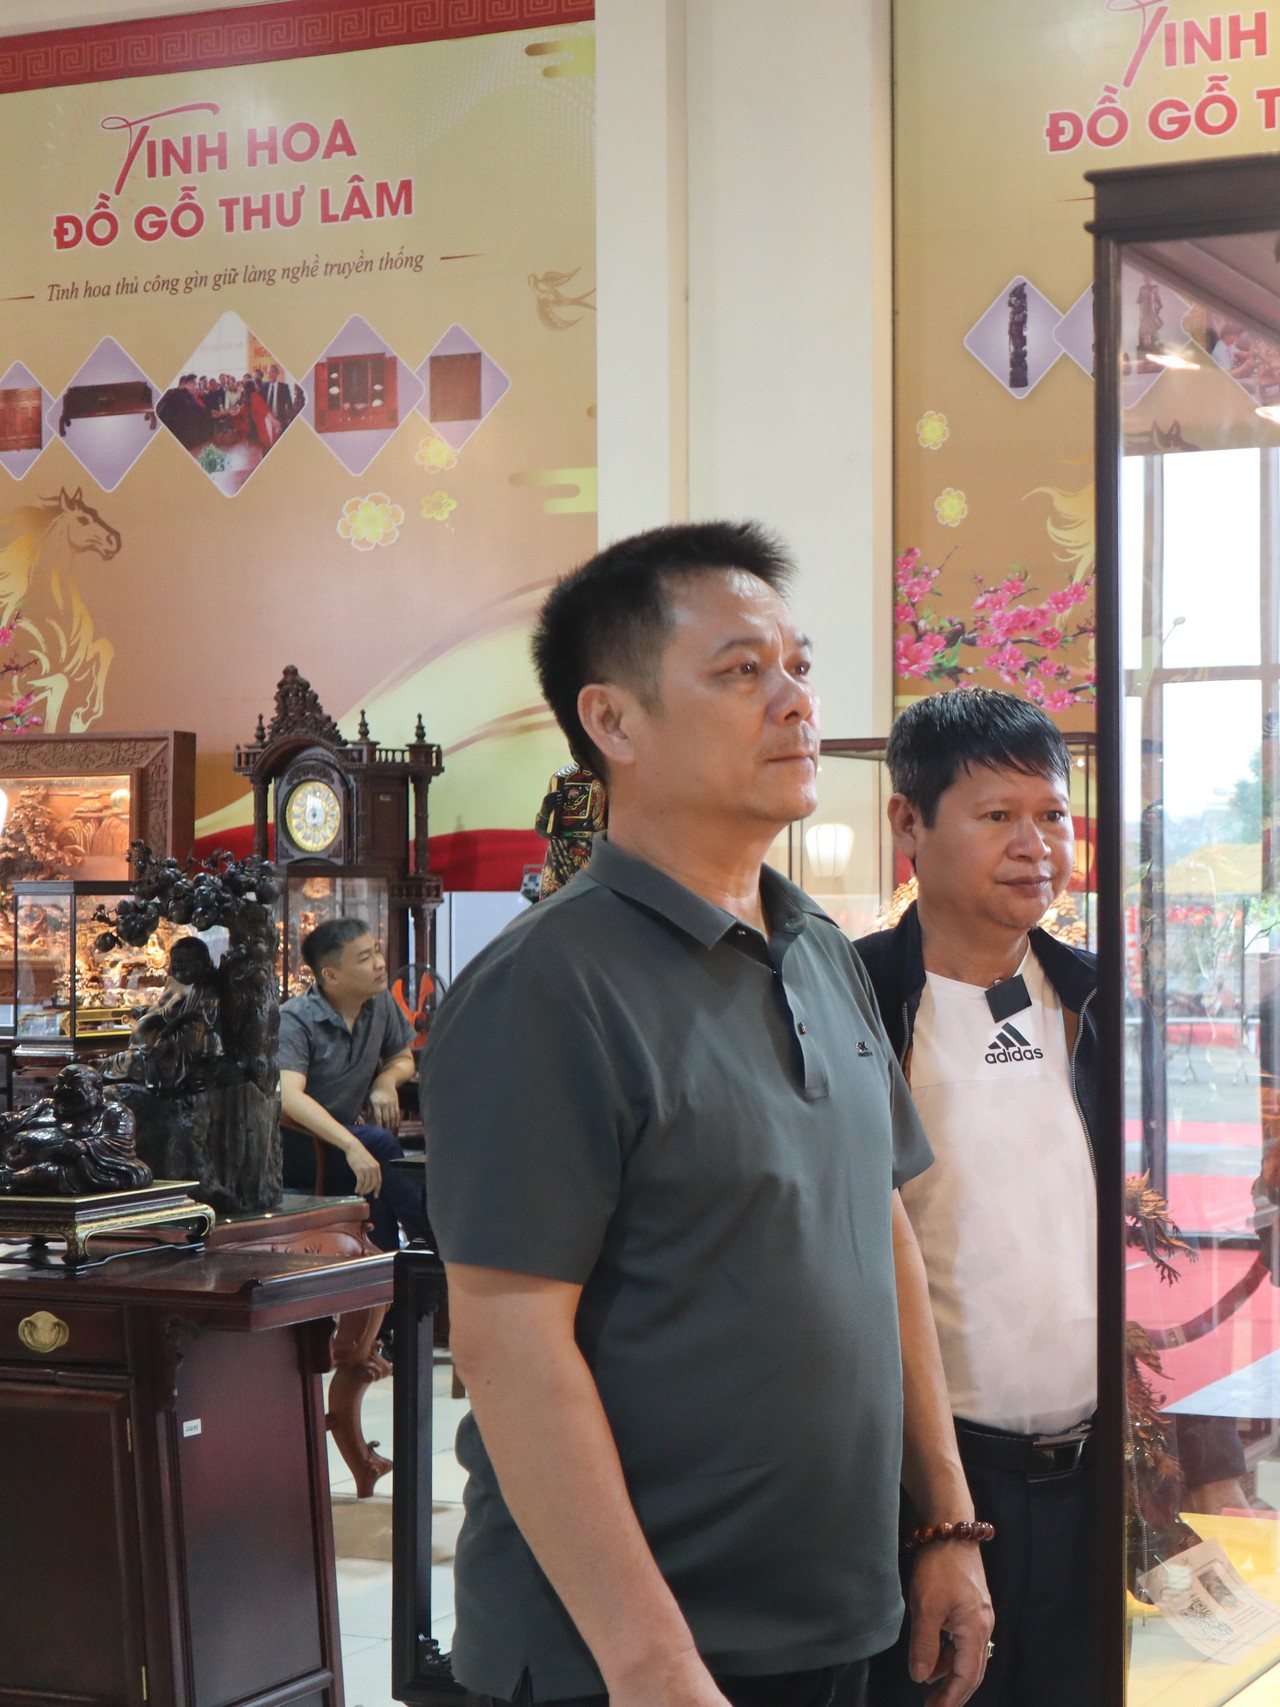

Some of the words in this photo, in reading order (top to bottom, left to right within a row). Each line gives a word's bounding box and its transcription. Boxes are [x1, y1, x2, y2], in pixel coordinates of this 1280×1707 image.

[1107, 0, 1267, 88] TINH
[101, 102, 227, 196] TINH
[248, 118, 357, 167] HOA
[1046, 85, 1129, 152] ĐỒ
[1148, 75, 1238, 141] GỖ
[54, 193, 119, 250] ĐỒ
[134, 186, 204, 241] GỖ
[219, 185, 305, 233] THƯ
[320, 174, 413, 224] LÂM
[48, 282, 79, 302] Tinh
[84, 281, 110, 298] hoa
[115, 276, 138, 295] thủ
[143, 275, 180, 295] công
[183, 271, 208, 294] gìn
[212, 268, 239, 291] giữ
[243, 265, 277, 286] làng
[281, 254, 319, 284] nghề
[323, 249, 373, 280] truyền
[378, 245, 424, 273] thống
[985, 1047, 1043, 1064] adidas
